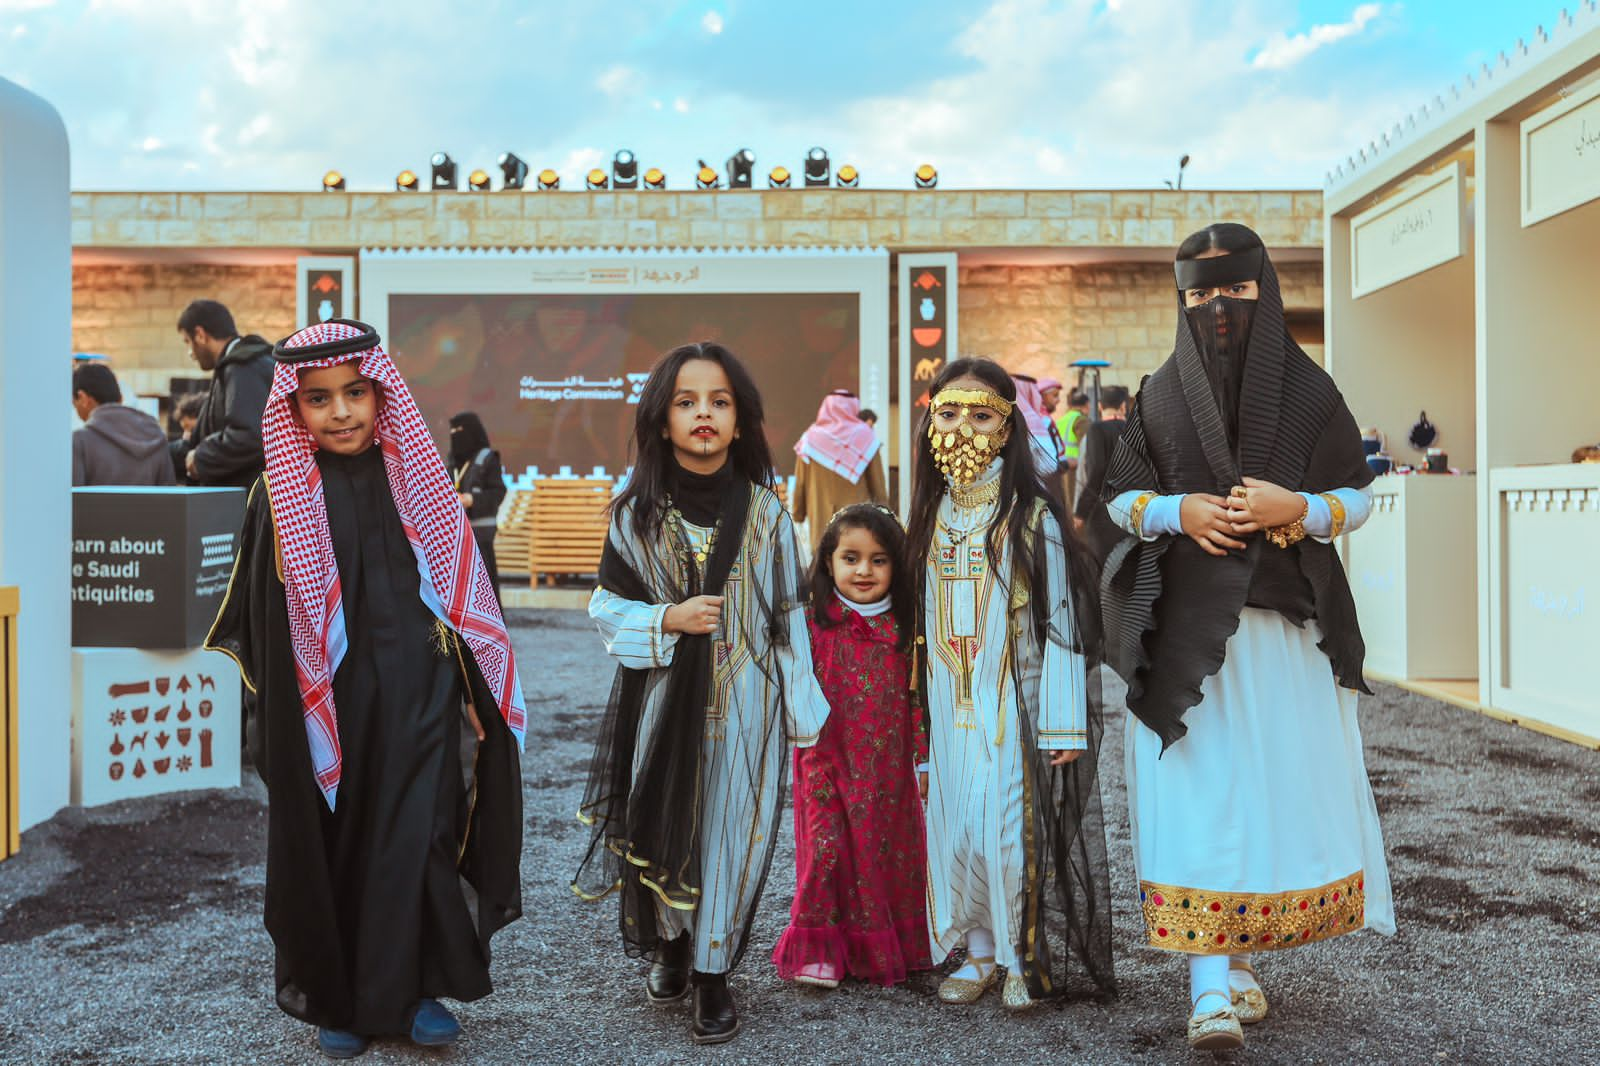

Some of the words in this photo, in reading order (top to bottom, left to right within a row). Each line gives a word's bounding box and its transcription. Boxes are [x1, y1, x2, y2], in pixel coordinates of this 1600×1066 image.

[520, 388, 562, 401] Heritage
[563, 388, 624, 399] Commission
[110, 536, 165, 555] about
[87, 560, 140, 578] Saudi
